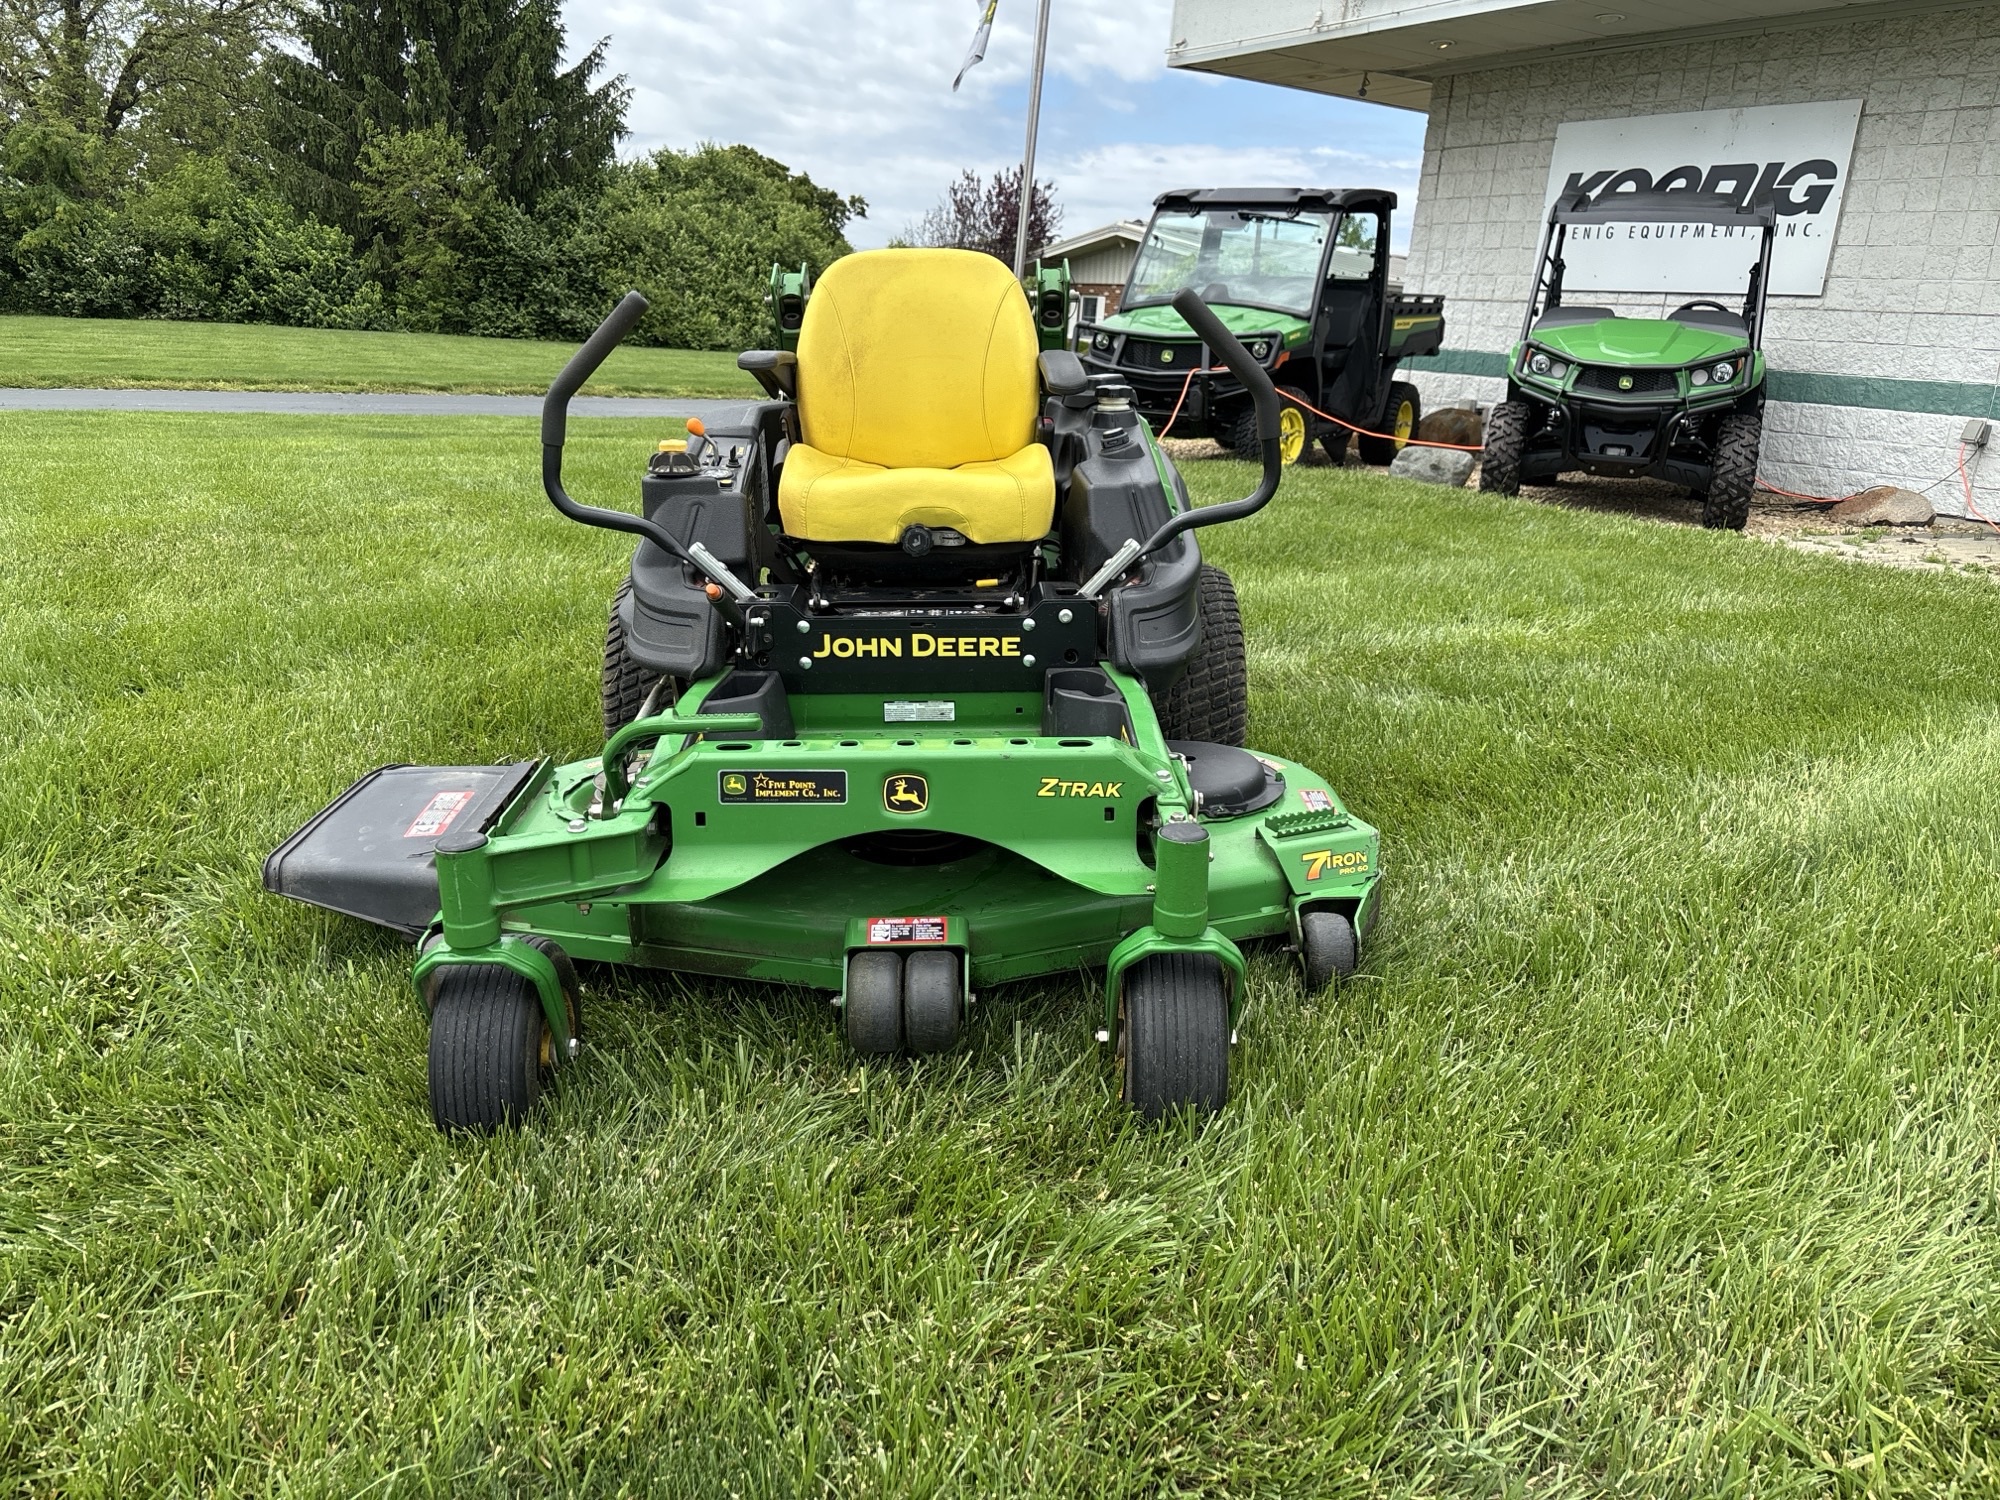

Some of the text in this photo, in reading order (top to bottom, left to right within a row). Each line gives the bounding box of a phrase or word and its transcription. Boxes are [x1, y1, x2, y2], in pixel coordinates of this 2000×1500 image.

[1774, 222, 1823, 238] INC.
[813, 633, 1021, 658] JOHN DEERE
[755, 788, 799, 797] IMPLEMENT
[1037, 777, 1123, 798] ZTRAK
[1339, 867, 1356, 875] PRO
